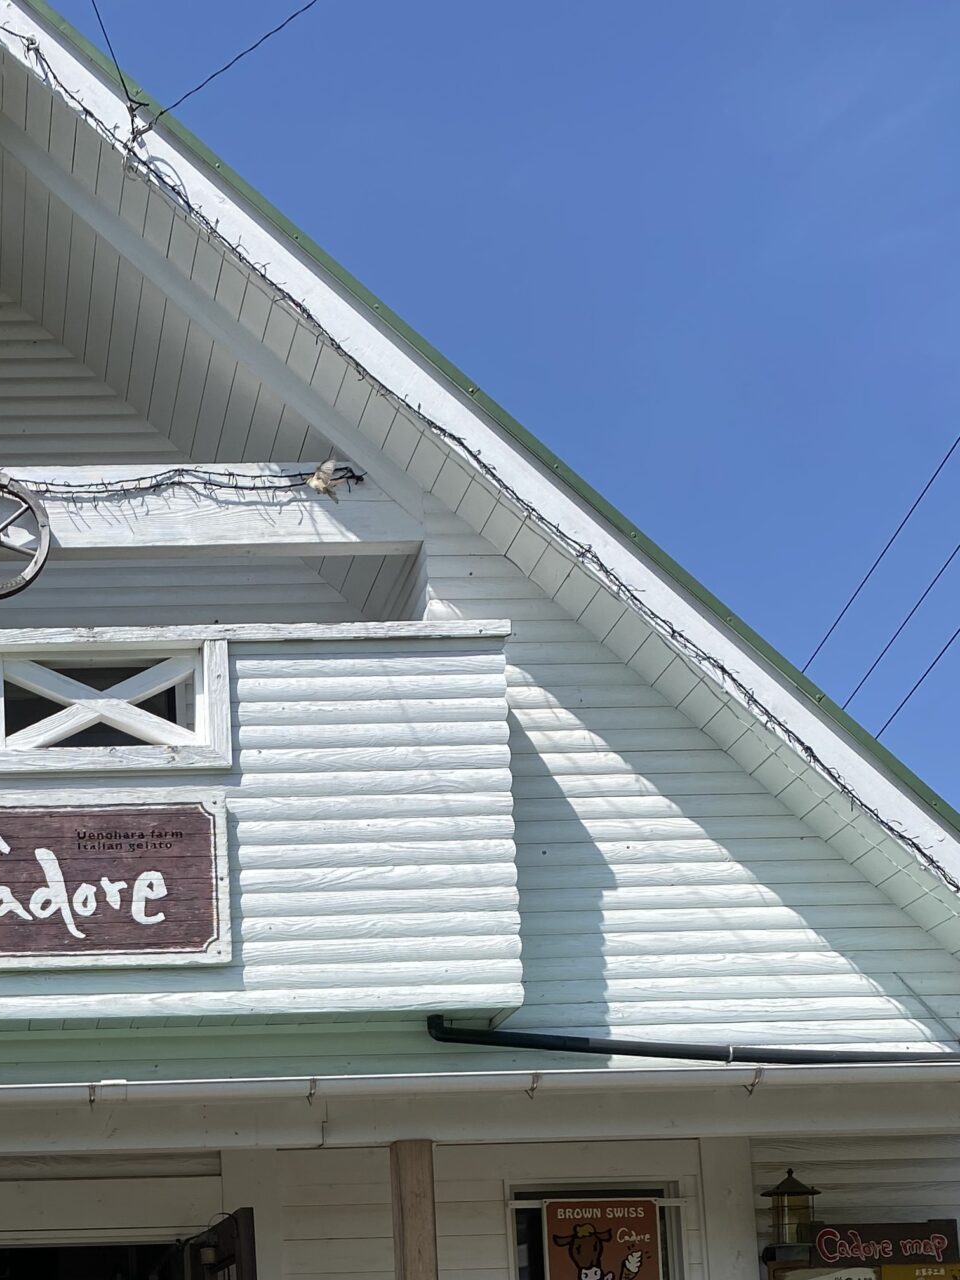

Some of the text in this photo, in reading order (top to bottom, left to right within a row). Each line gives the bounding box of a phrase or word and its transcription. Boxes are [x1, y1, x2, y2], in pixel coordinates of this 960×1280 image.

[76, 829, 183, 840] Uenohara farm
[77, 841, 173, 852] Italian gelato
[557, 1207, 645, 1219] BROWN SWISS
[616, 1227, 651, 1244] Cadore
[815, 1228, 948, 1263] Cadore map
